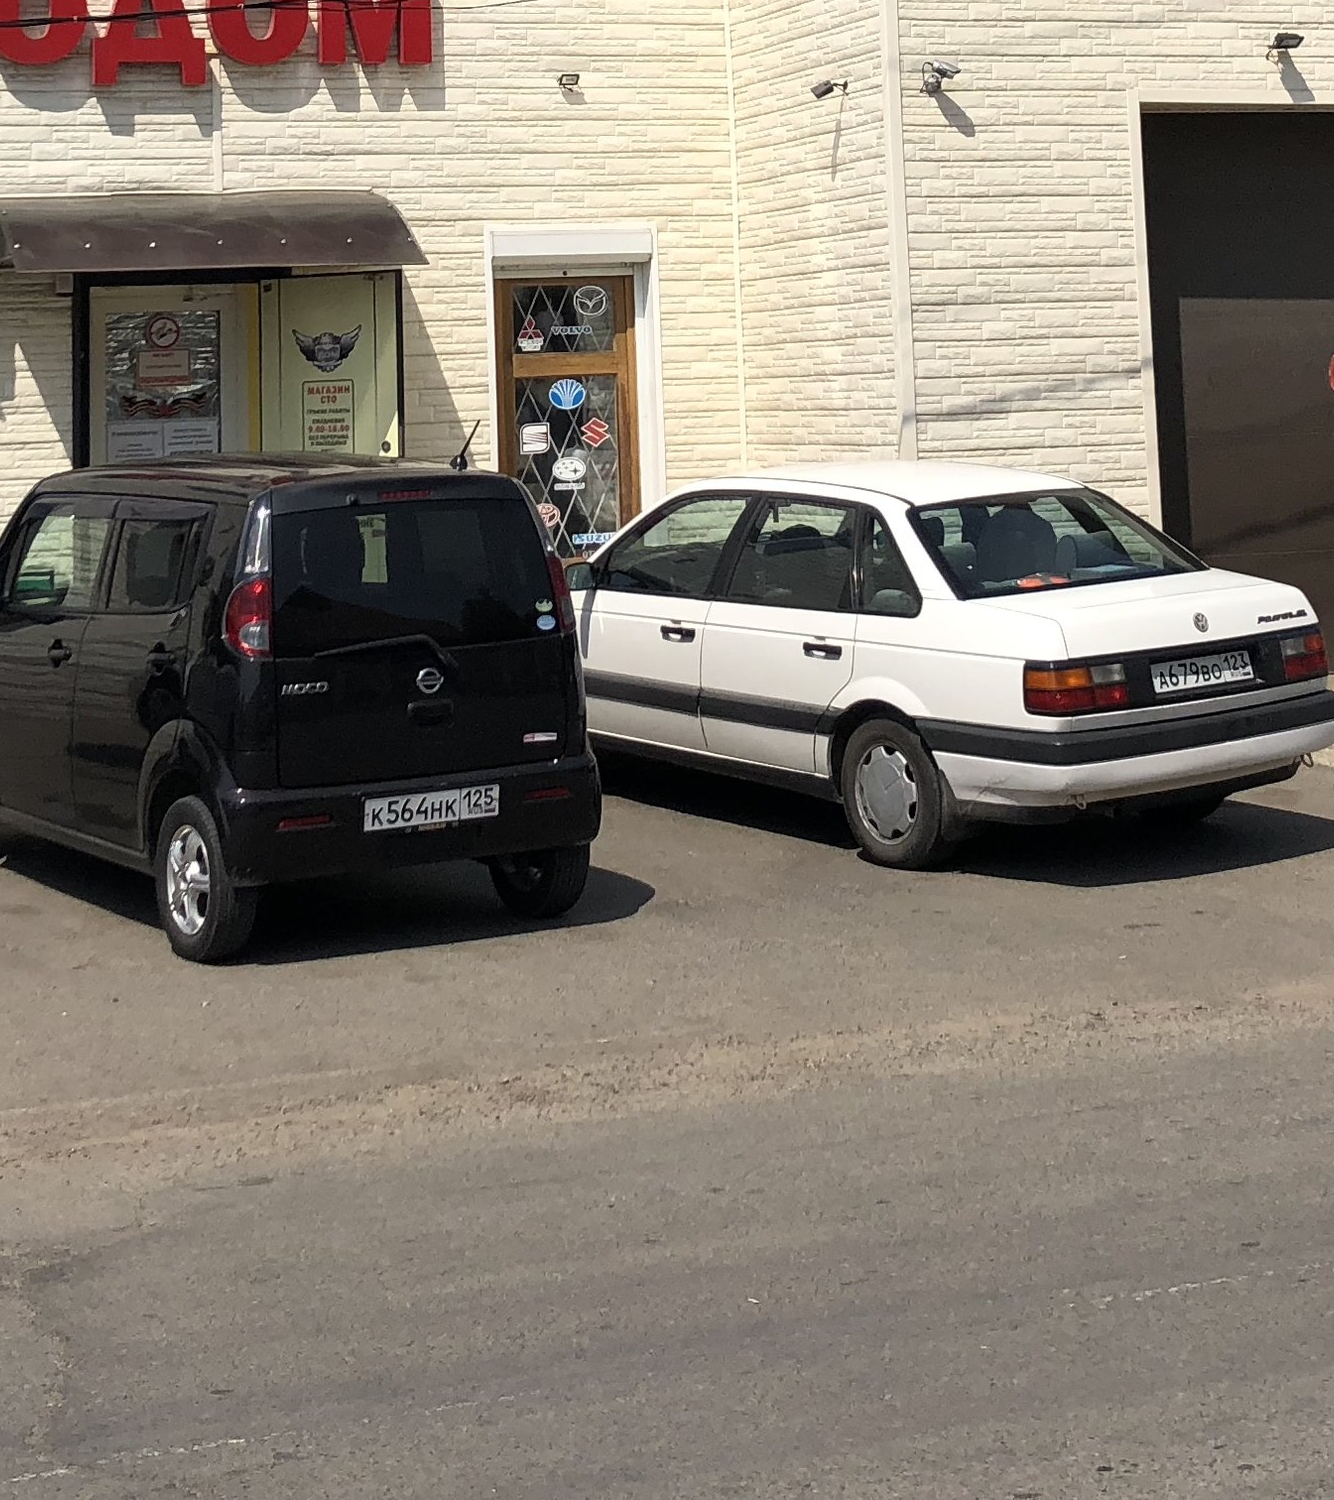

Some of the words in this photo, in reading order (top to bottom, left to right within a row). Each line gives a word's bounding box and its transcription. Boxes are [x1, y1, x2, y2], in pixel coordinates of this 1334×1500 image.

[552, 326, 592, 335] VOLVO
[308, 385, 350, 395] МАГАЗИН
[321, 395, 337, 404] СТО
[1160, 662, 1222, 689] А679ВО
[1223, 652, 1249, 671] 123
[371, 797, 457, 828] К564НК
[463, 787, 494, 808] 125
